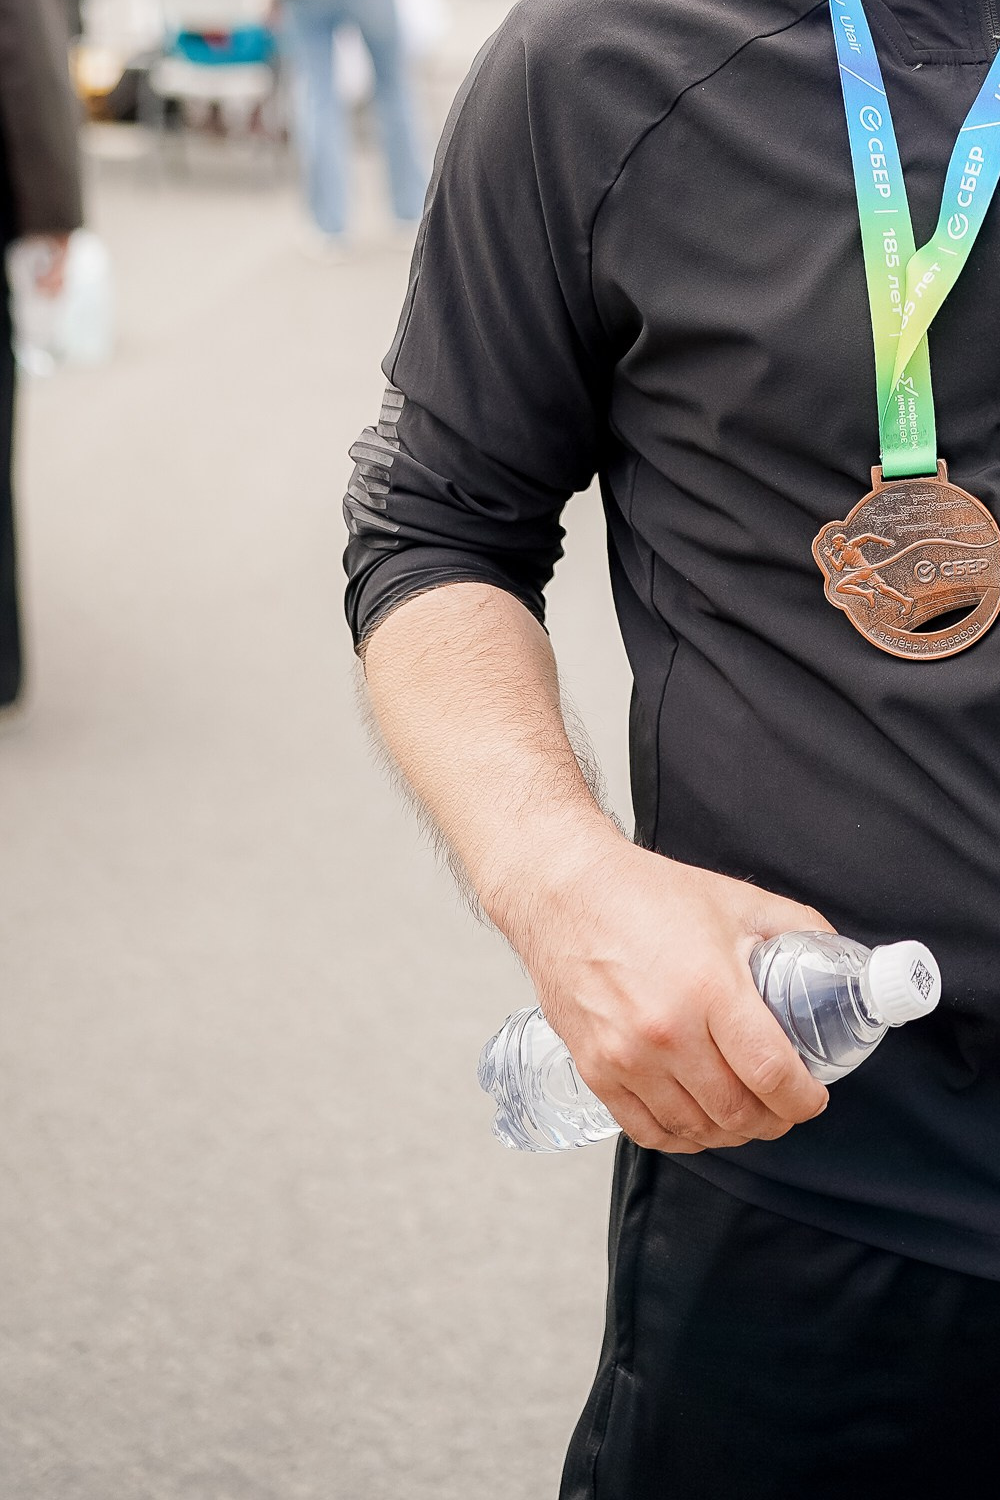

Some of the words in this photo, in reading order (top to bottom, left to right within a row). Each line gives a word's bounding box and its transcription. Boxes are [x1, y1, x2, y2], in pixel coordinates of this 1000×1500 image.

[839, 14, 863, 55] Utair
[867, 136, 891, 198] СБЕР
[914, 261, 942, 299] лет
[956, 145, 986, 208] СБЕР
[882, 227, 900, 269] 185
[887, 274, 904, 318] лет
[894, 393, 909, 445] зелёный
[907, 397, 920, 451] марафон
[939, 558, 990, 578] СБЕР
[877, 630, 930, 651] зелёный
[932, 621, 982, 650] марафон
